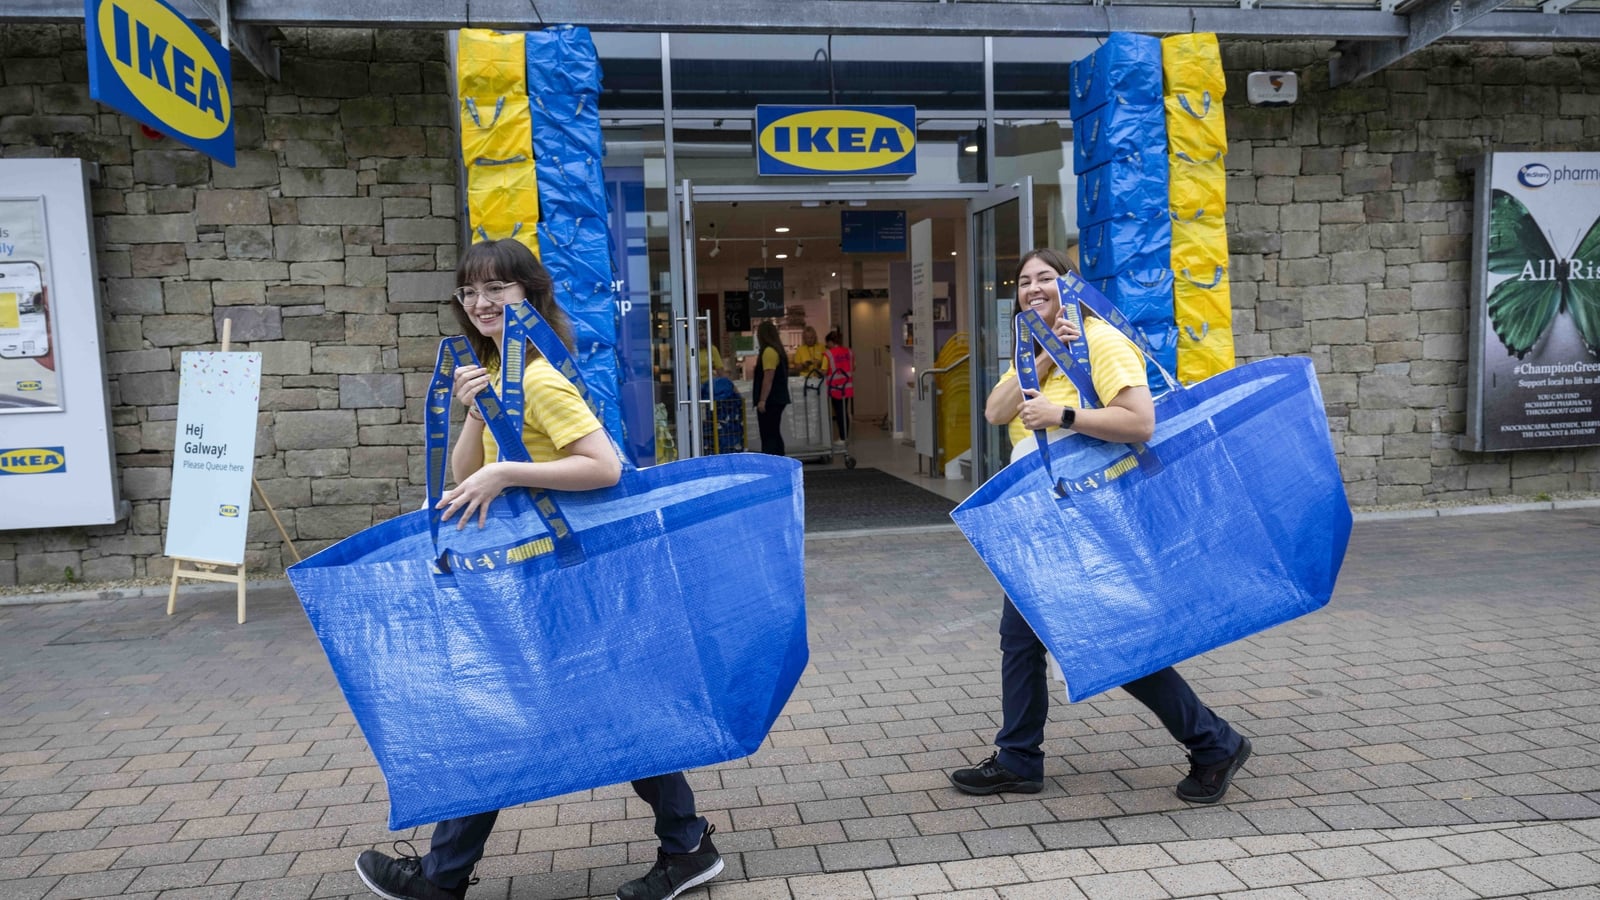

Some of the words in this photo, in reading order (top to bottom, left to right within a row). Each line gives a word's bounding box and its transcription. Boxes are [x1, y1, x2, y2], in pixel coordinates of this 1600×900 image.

[112, 3, 225, 124] IKEA
[773, 126, 906, 153] IKEA
[1518, 258, 1557, 281] All
[1023, 310, 1073, 370] IKEA
[1518, 378, 1546, 389] Support
[1547, 377, 1564, 386] local
[1565, 377, 1573, 385] to
[1573, 376, 1584, 385] lift
[185, 423, 204, 440] Hej
[184, 441, 227, 459] Galway!
[1, 454, 60, 468] IKEA
[183, 460, 205, 470] Please
[205, 461, 228, 472] Queue
[229, 462, 245, 472] here
